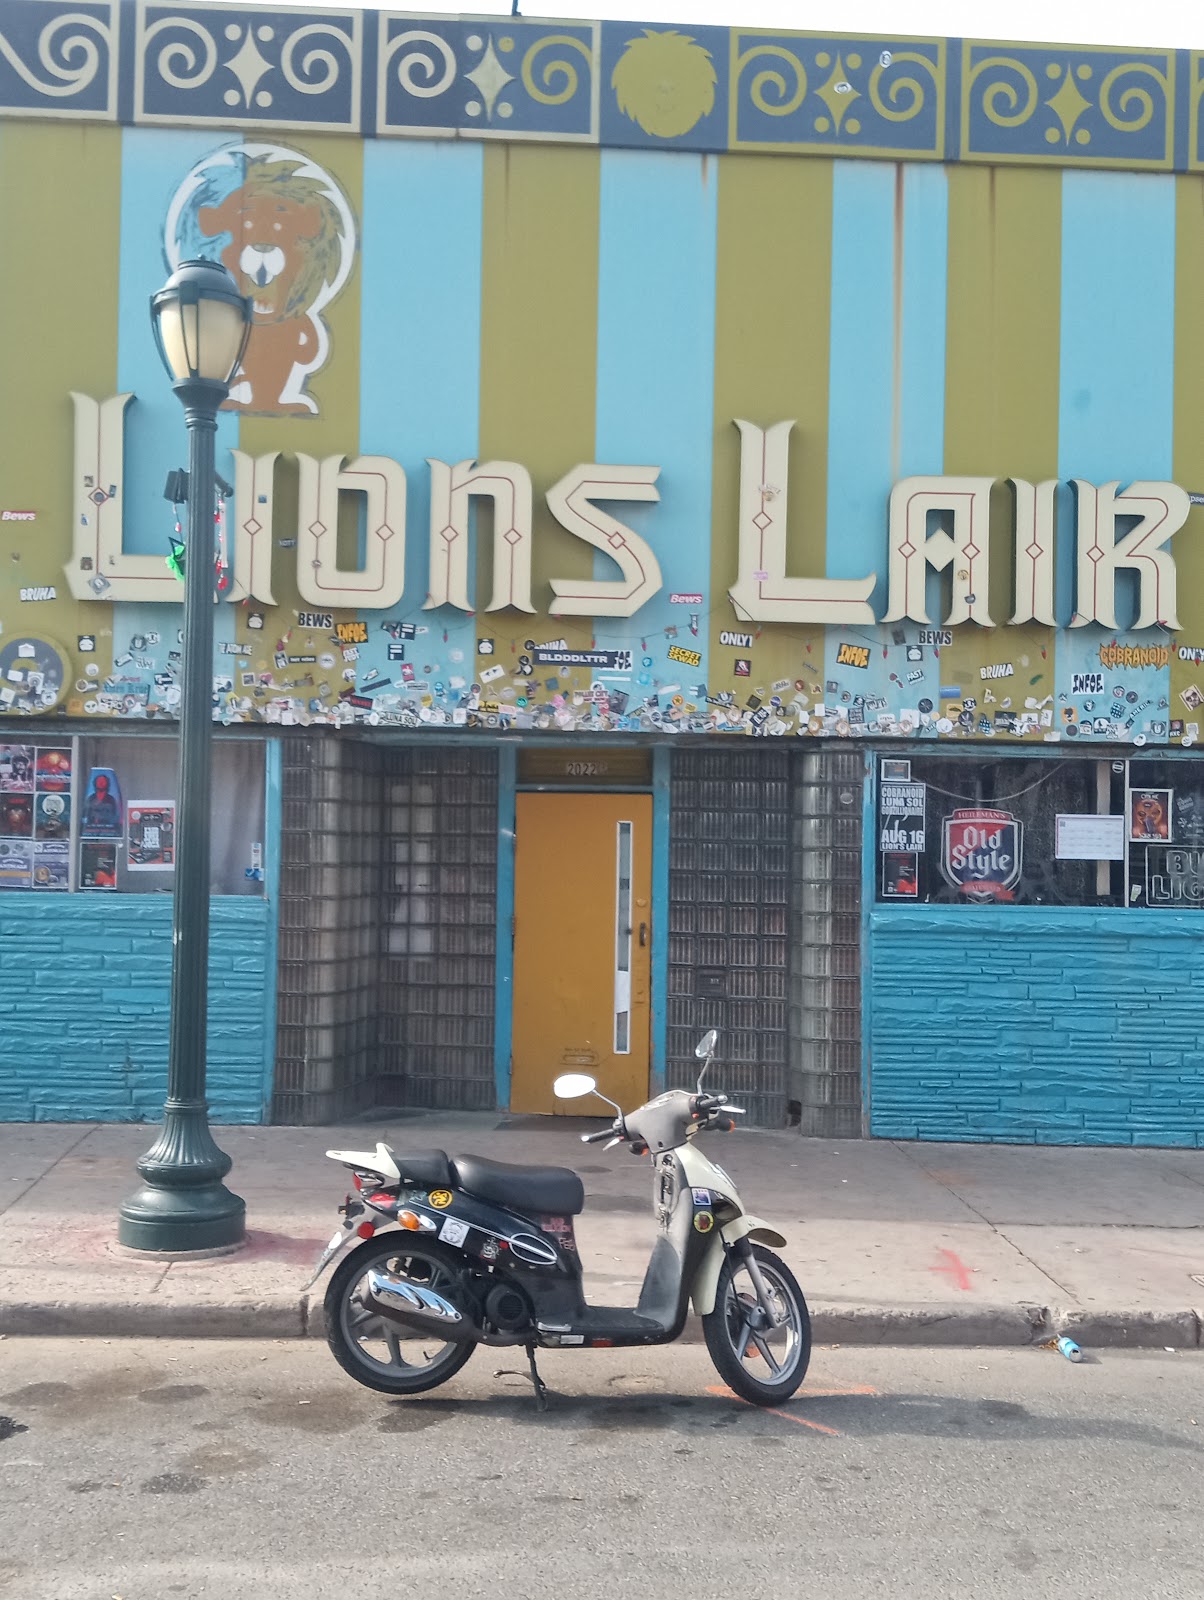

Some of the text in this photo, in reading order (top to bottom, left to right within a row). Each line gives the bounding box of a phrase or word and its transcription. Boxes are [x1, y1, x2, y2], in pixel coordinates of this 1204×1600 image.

[1, 511, 36, 521] Bews
[670, 594, 702, 603] Bews
[299, 613, 332, 628] BEWS
[919, 630, 952, 645] BEWS
[667, 653, 700, 666] SKWAD
[670, 646, 701, 660] SECRET
[1097, 643, 1169, 671] COBRANOID
[568, 763, 597, 776] 2022
[881, 787, 924, 798] COBRANOID
[882, 797, 924, 807] LUNA SOL
[881, 829, 924, 844] AUG 16
[963, 825, 1002, 850] Old
[951, 844, 1011, 879] Style
[1166, 850, 1204, 876] BU
